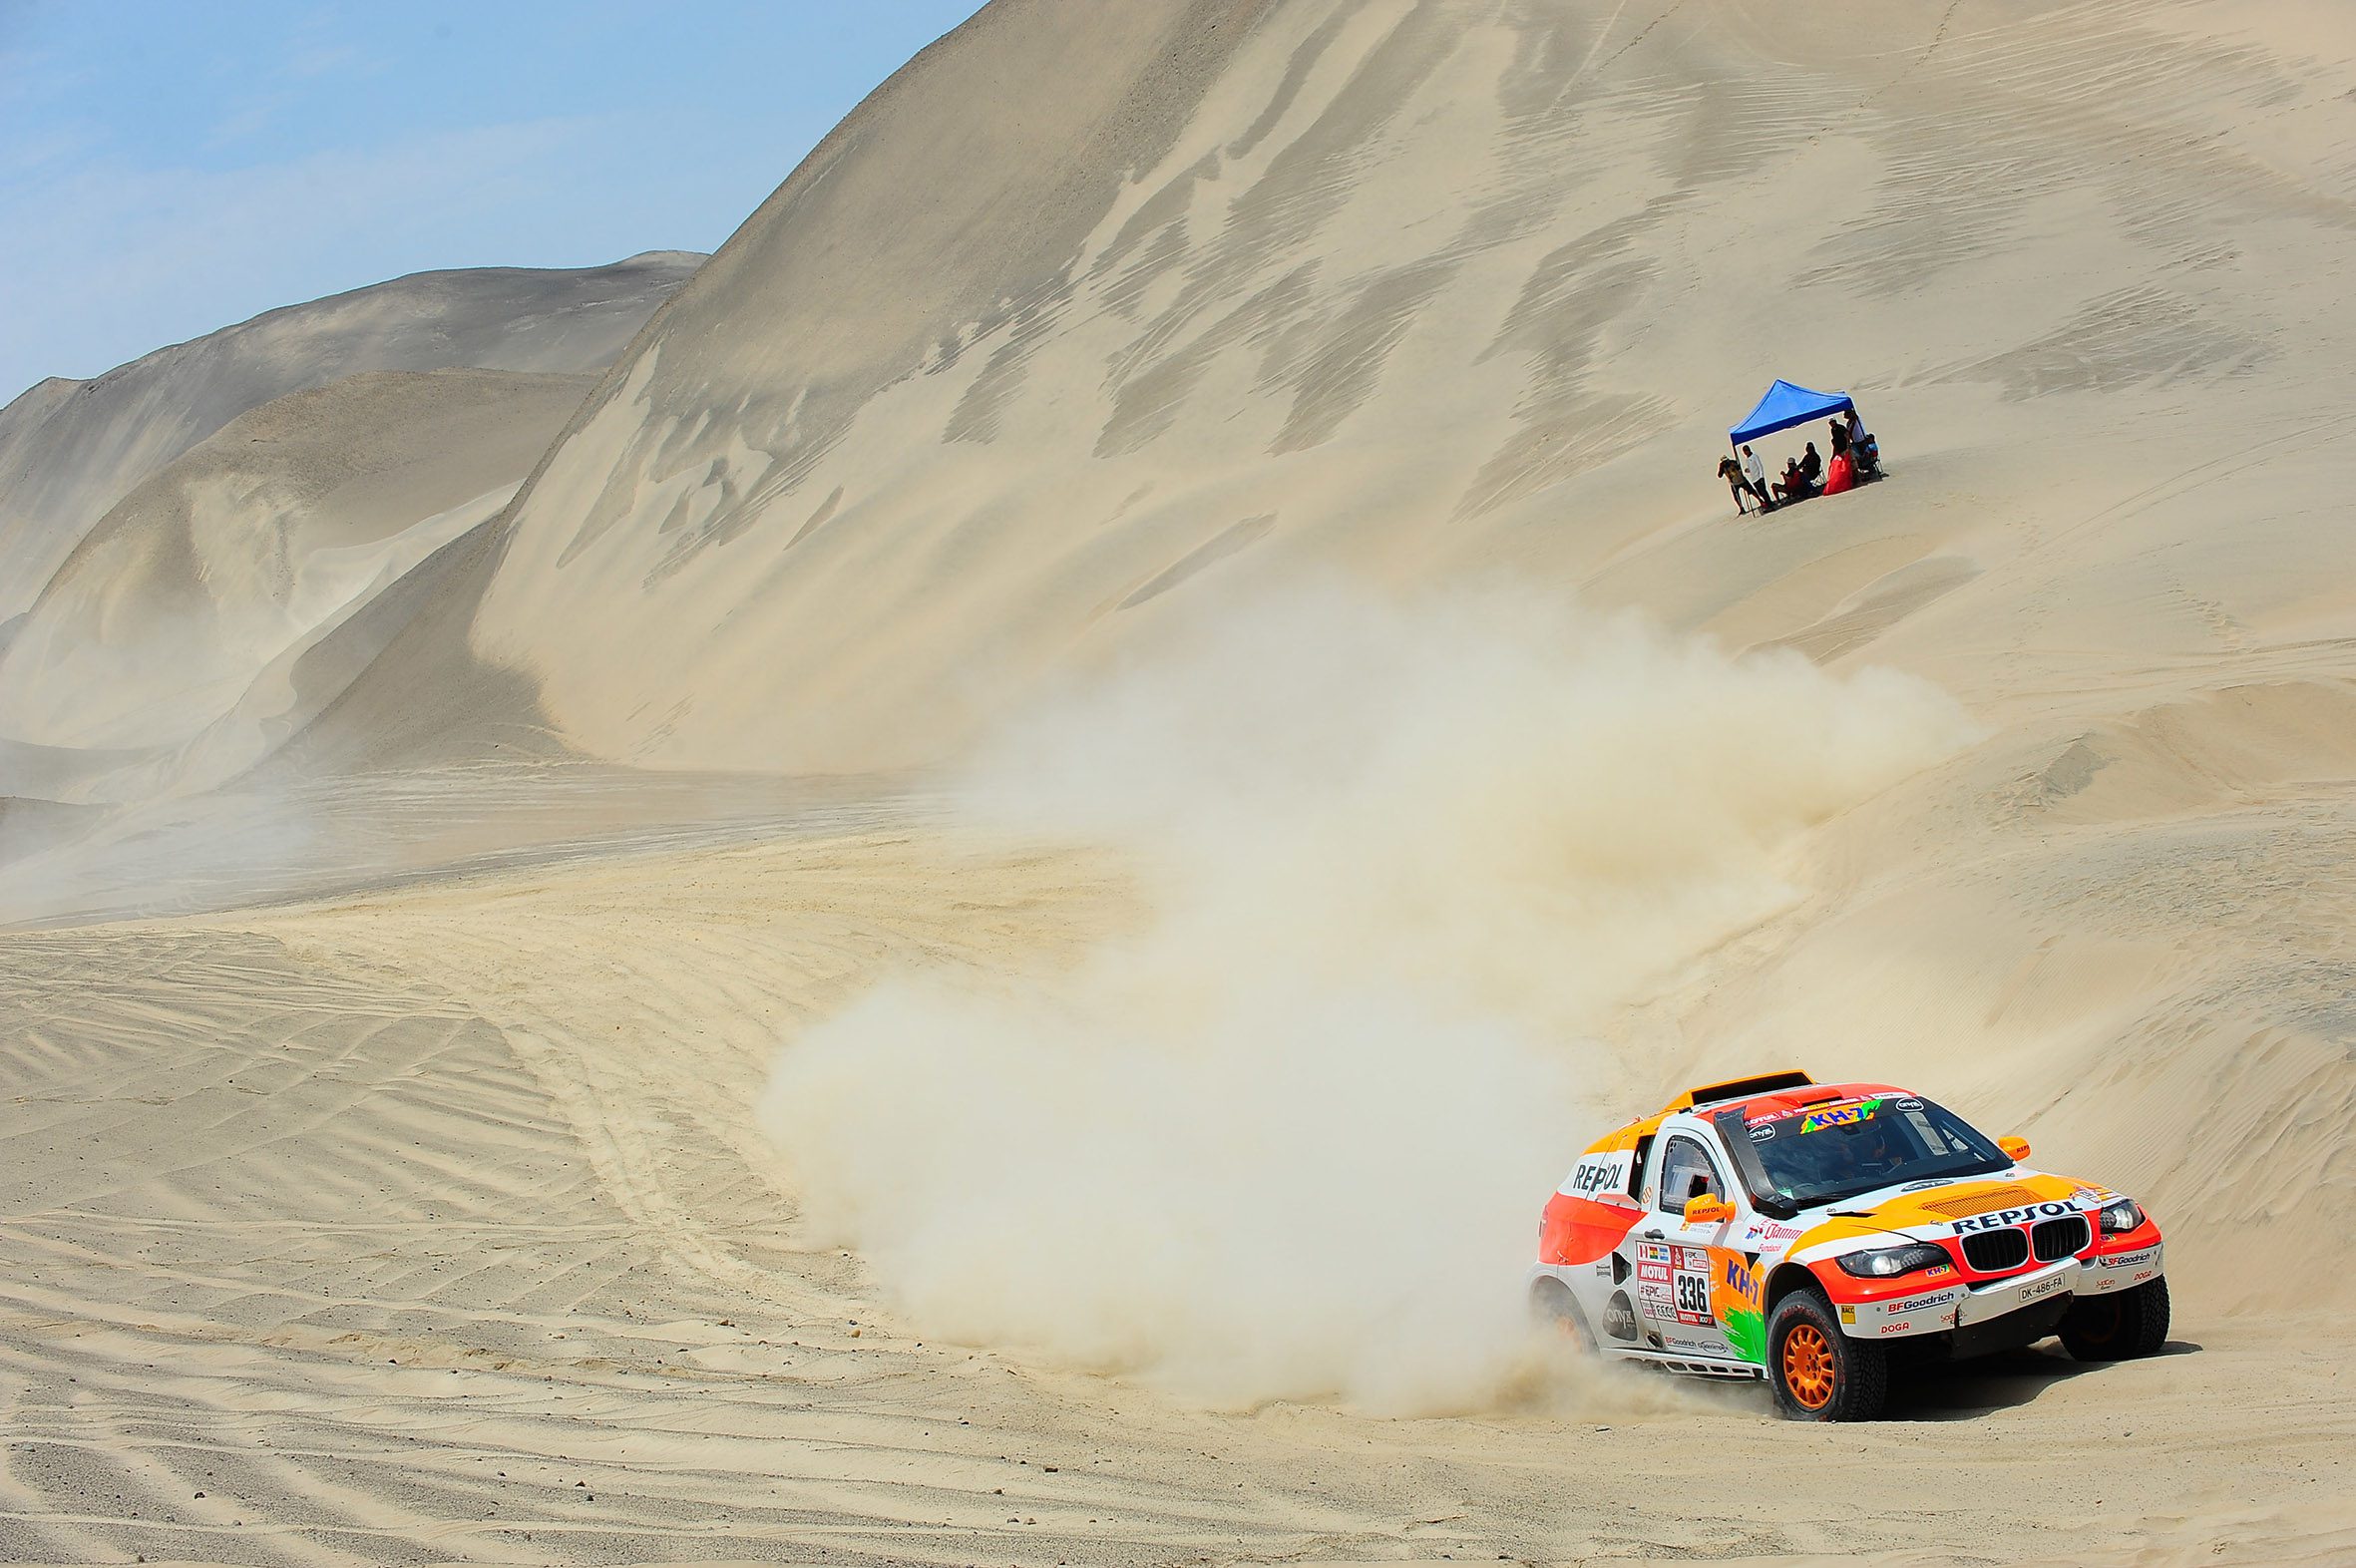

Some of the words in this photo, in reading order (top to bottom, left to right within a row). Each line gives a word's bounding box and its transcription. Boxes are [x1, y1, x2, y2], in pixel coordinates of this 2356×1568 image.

[1809, 1107, 1864, 1126] KH-7
[1573, 1163, 1623, 1192] REPOL
[1693, 1206, 1721, 1215] REPSOL
[1952, 1201, 2083, 1234] REPSOL
[1764, 1223, 1803, 1240] Damm
[1641, 1264, 1669, 1281] MOTUL
[1927, 1266, 1948, 1276] KH-7
[1727, 1259, 1759, 1306] KH-7
[2022, 1278, 2062, 1300] DK-486-FA
[1678, 1275, 1708, 1313] 336
[1888, 1292, 1954, 1313] BFGoodrich
[1881, 1322, 1909, 1334] DOGA
